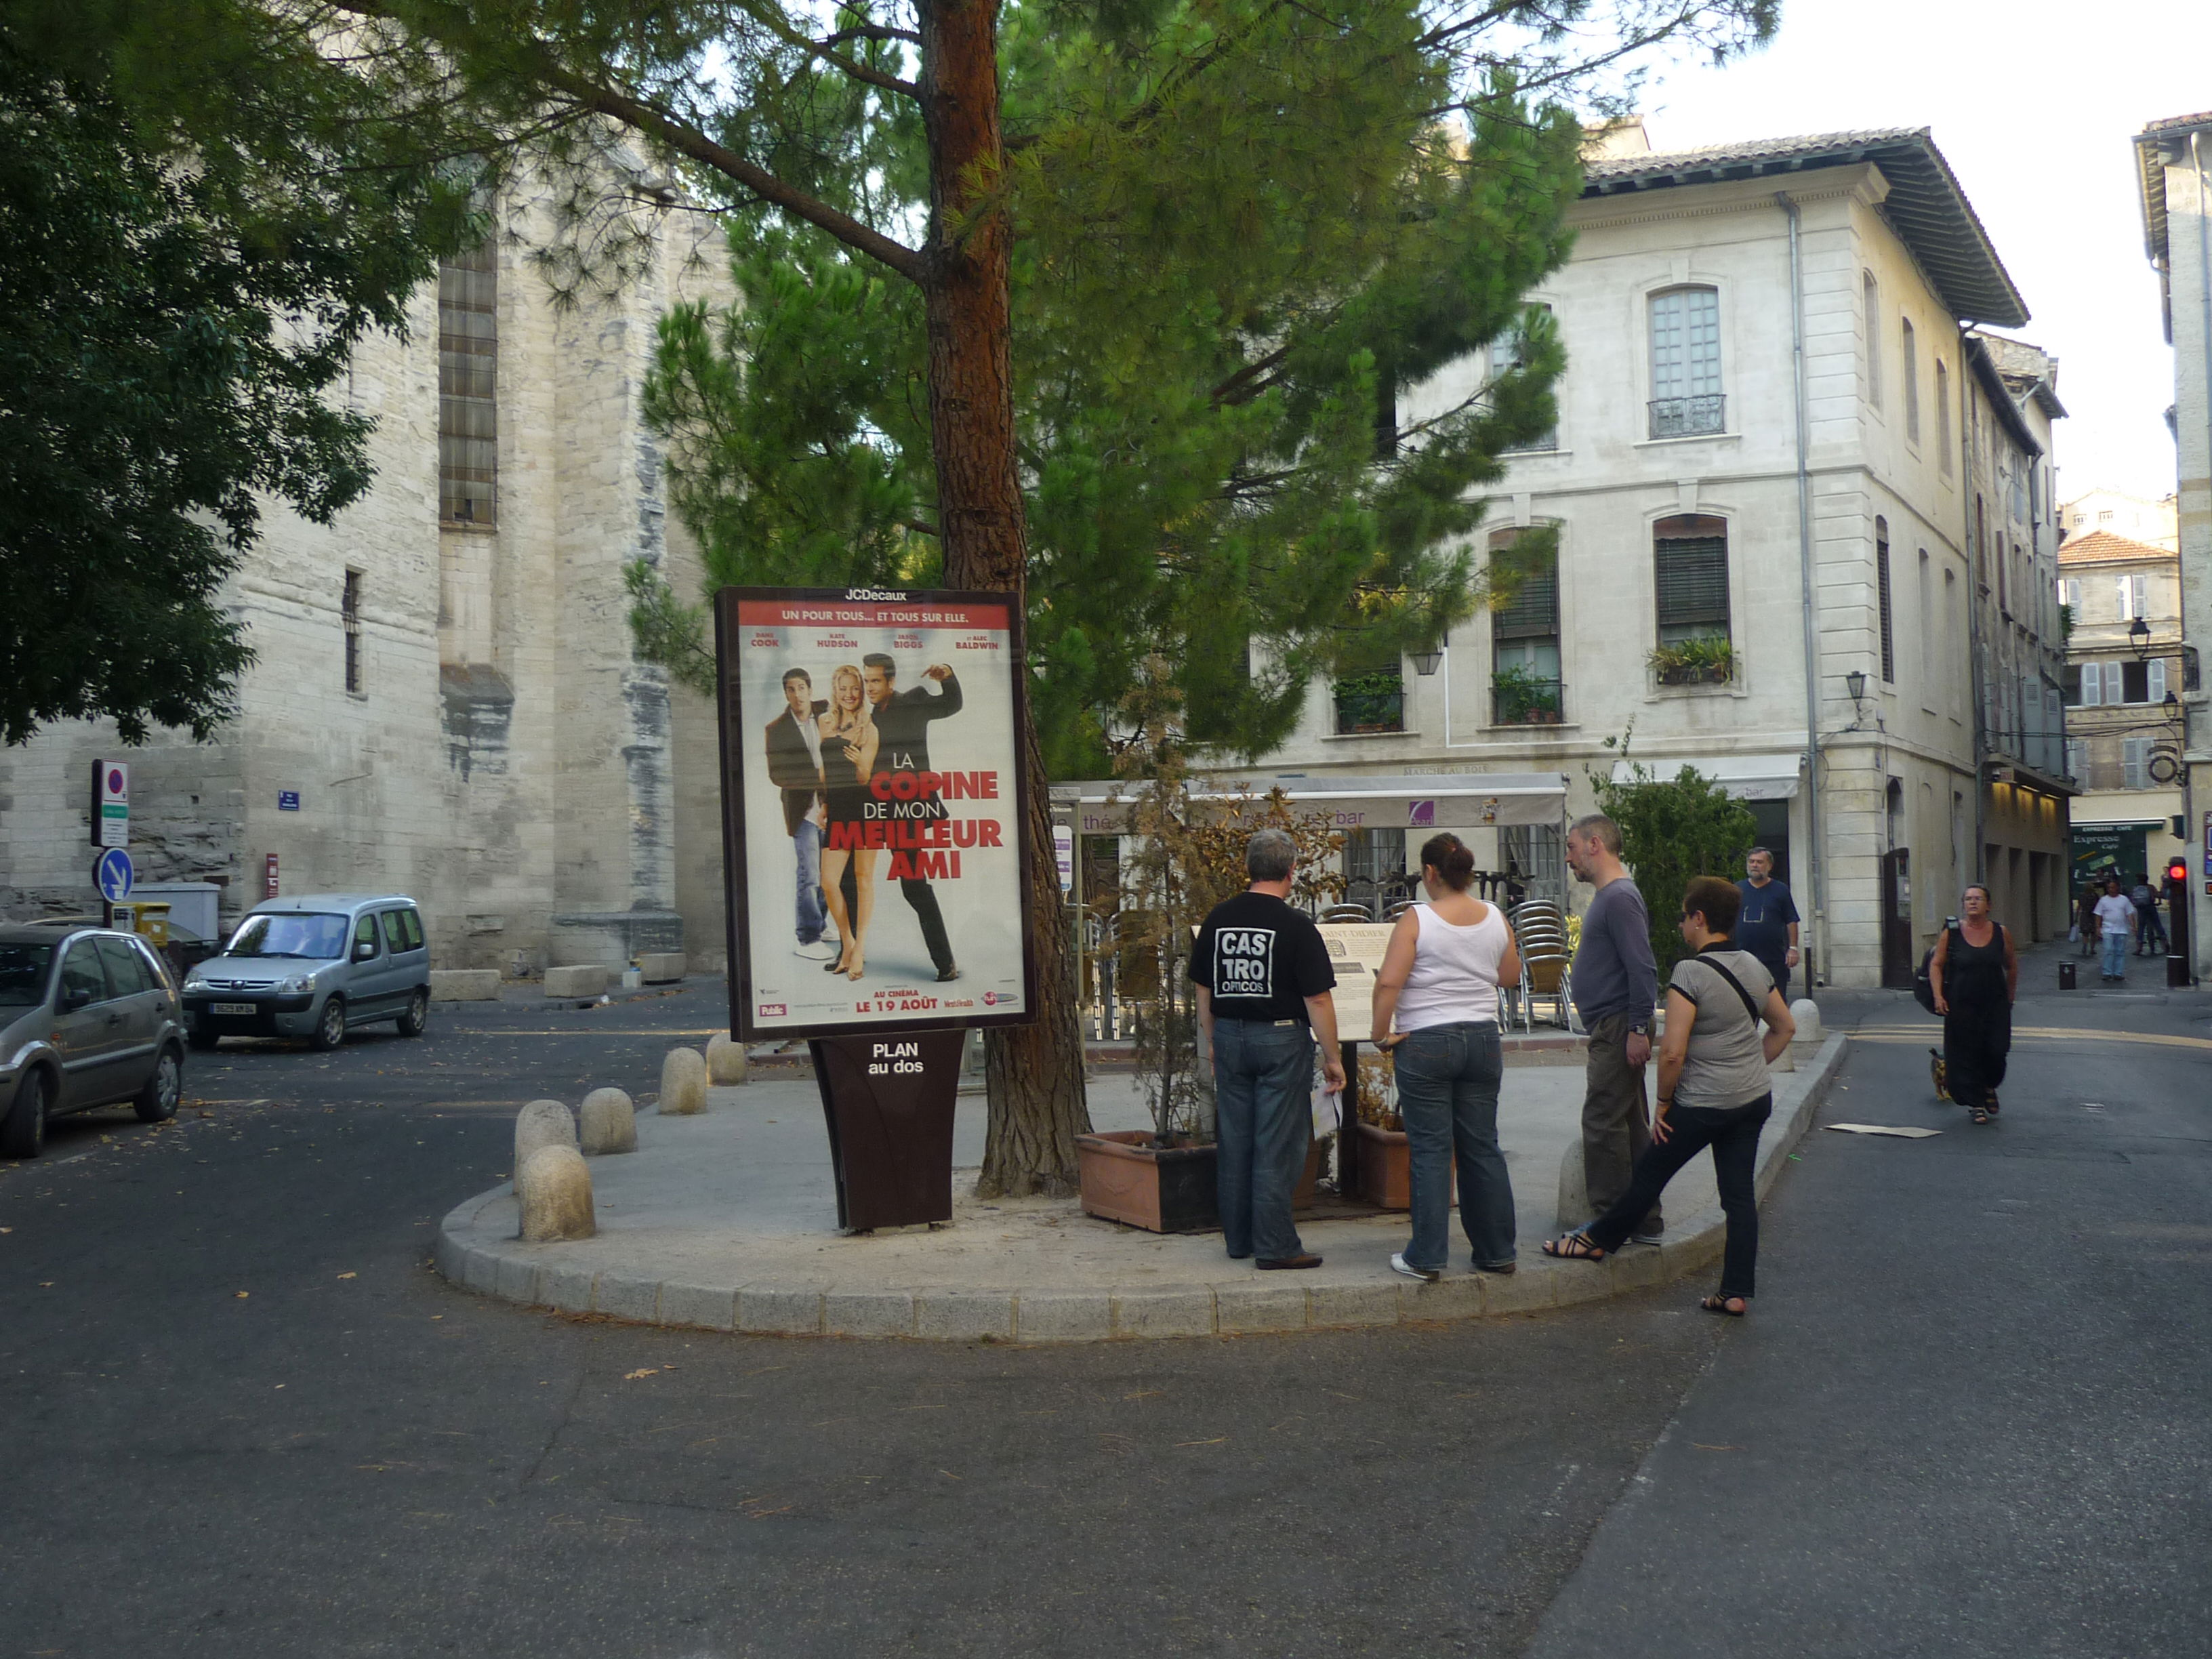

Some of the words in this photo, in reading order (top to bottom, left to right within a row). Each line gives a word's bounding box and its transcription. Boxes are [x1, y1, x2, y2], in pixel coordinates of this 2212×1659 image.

[845, 589, 907, 601] JCDecaux
[781, 609, 800, 620] UN
[802, 611, 833, 621] POUR
[836, 611, 874, 621] TOUS...
[877, 612, 888, 621] ET
[890, 612, 920, 622] TOUS
[922, 613, 942, 622] SUR
[945, 613, 969, 623] ELLE.
[750, 639, 779, 648] COOK
[817, 640, 859, 648] HUDSON
[956, 642, 998, 650] BALDWIN
[893, 752, 915, 769] LA
[1464, 765, 1488, 774] BOIS
[869, 771, 998, 800] COPINE
[1745, 787, 1764, 796] bar
[864, 802, 887, 819] DE
[893, 802, 941, 819] MON
[1336, 809, 1365, 825] bar
[1410, 815, 1433, 825] Pearl
[829, 819, 1004, 851] MEILLEUR
[886, 850, 961, 881] AMI
[1221, 933, 1267, 956] CAS
[1221, 958, 1265, 980] TRO
[874, 991, 886, 999] AU
[762, 1006, 784, 1015] Public
[856, 1001, 871, 1012] LE
[877, 1000, 895, 1012] 19
[900, 995, 937, 1010] AOÛT
[873, 1042, 918, 1057] PLAN
[868, 1062, 889, 1074] au
[893, 1059, 924, 1073] dos
